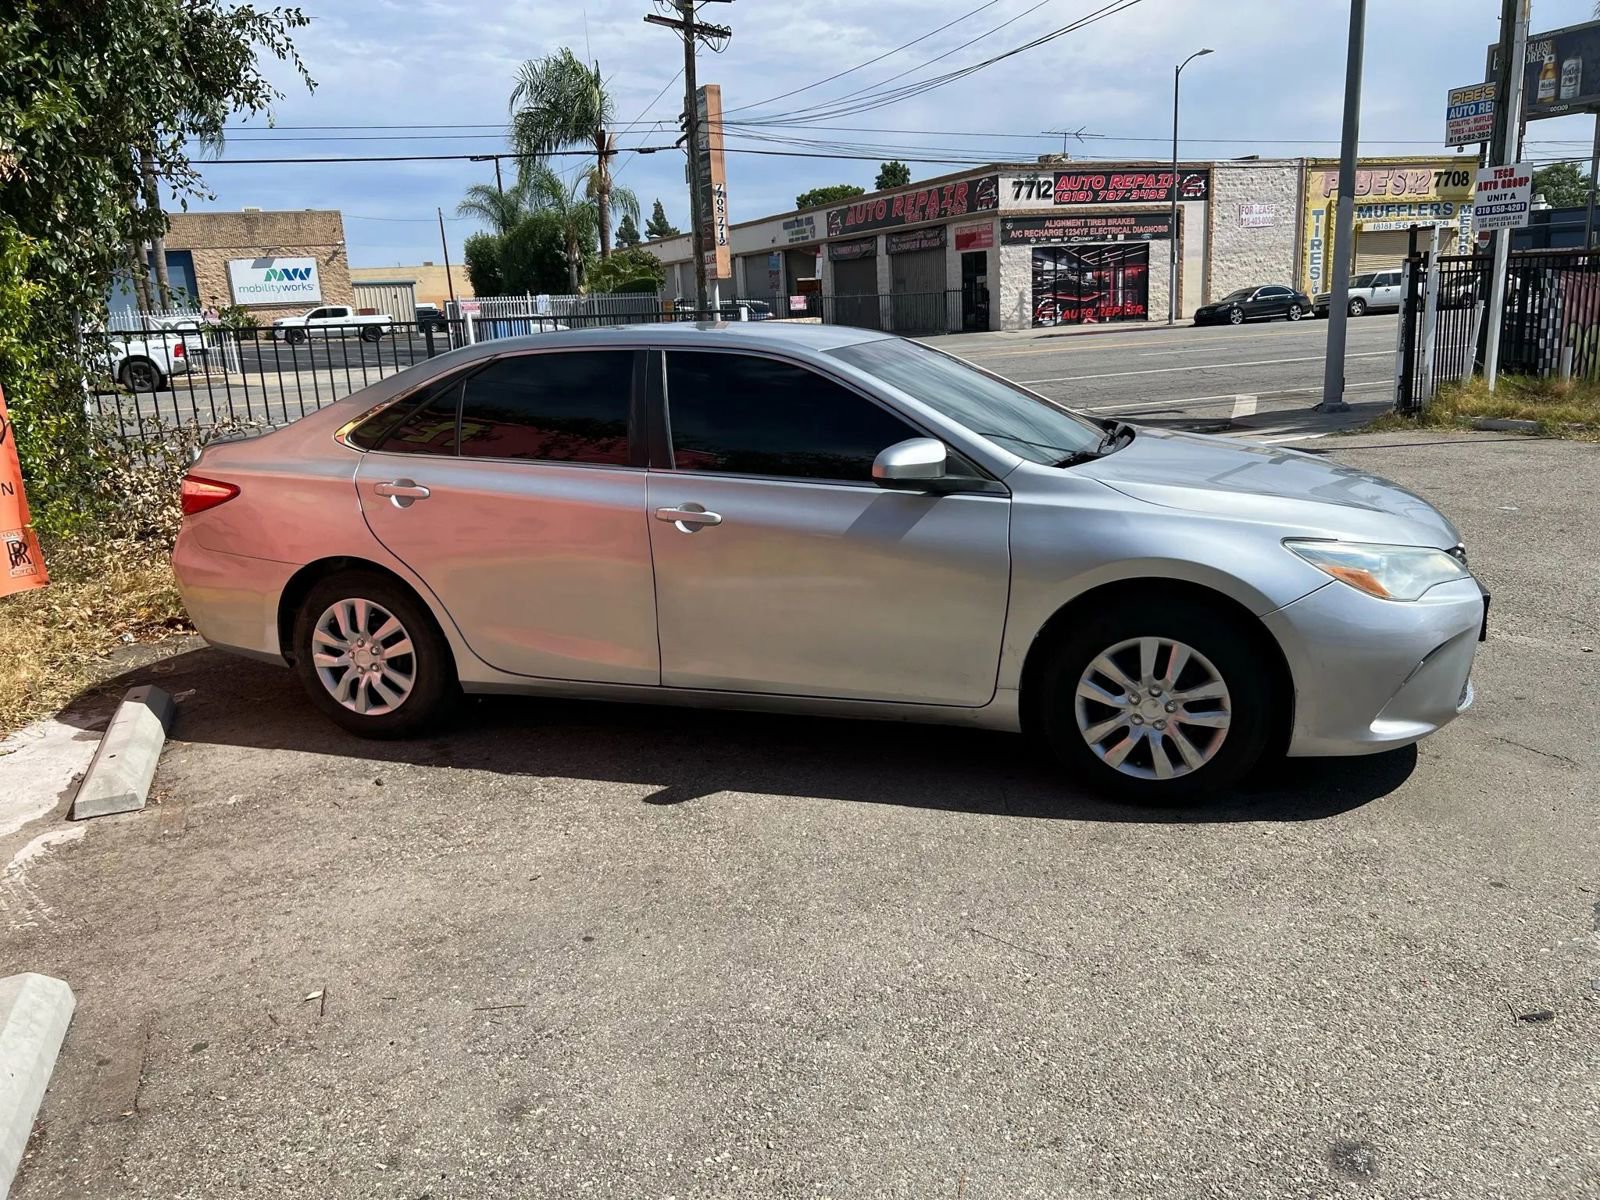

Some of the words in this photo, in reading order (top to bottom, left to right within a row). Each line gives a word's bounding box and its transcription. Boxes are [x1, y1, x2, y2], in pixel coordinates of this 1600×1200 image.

[1451, 86, 1496, 106] PIBE'S
[1449, 104, 1476, 119] AUTO
[1478, 100, 1494, 113] RE
[1055, 175, 1105, 190] AUTO
[1109, 173, 1180, 189] REPAIR
[1434, 171, 1469, 188] 7708
[1493, 168, 1514, 179] TECH
[1012, 180, 1053, 201] 7712
[1323, 169, 1407, 198] PBE'S
[1477, 181, 1499, 192] AUTO
[1501, 176, 1530, 189] GROUP
[715, 183, 725, 213] 7708
[1055, 191, 1093, 202] (818)
[1099, 189, 1167, 200] 787-3492
[1487, 194, 1508, 202] UNIT
[1509, 192, 1516, 200] A
[845, 200, 887, 226] AUTO
[891, 182, 969, 218] REPAIR
[1241, 206, 1254, 215] FOR
[1255, 205, 1274, 215] LEASE
[1356, 203, 1453, 218] MUFFLERS
[1477, 207, 1491, 215] 310
[1045, 219, 1086, 228] ALIGNMENT
[1087, 218, 1106, 226] TIRES
[1107, 217, 1136, 225] BRAKES
[717, 217, 727, 246] 7712
[1010, 230, 1023, 238] A/C
[1024, 229, 1064, 238] RECHARGE
[1065, 228, 1089, 236] 1234YF
[1090, 226, 1131, 235] ELECTRICAL
[1133, 225, 1168, 233] DIAGNOSIS
[1310, 210, 1324, 280] TIRES
[239, 283, 314, 294] mobilityworks
[1063, 308, 1094, 320] AUTO
